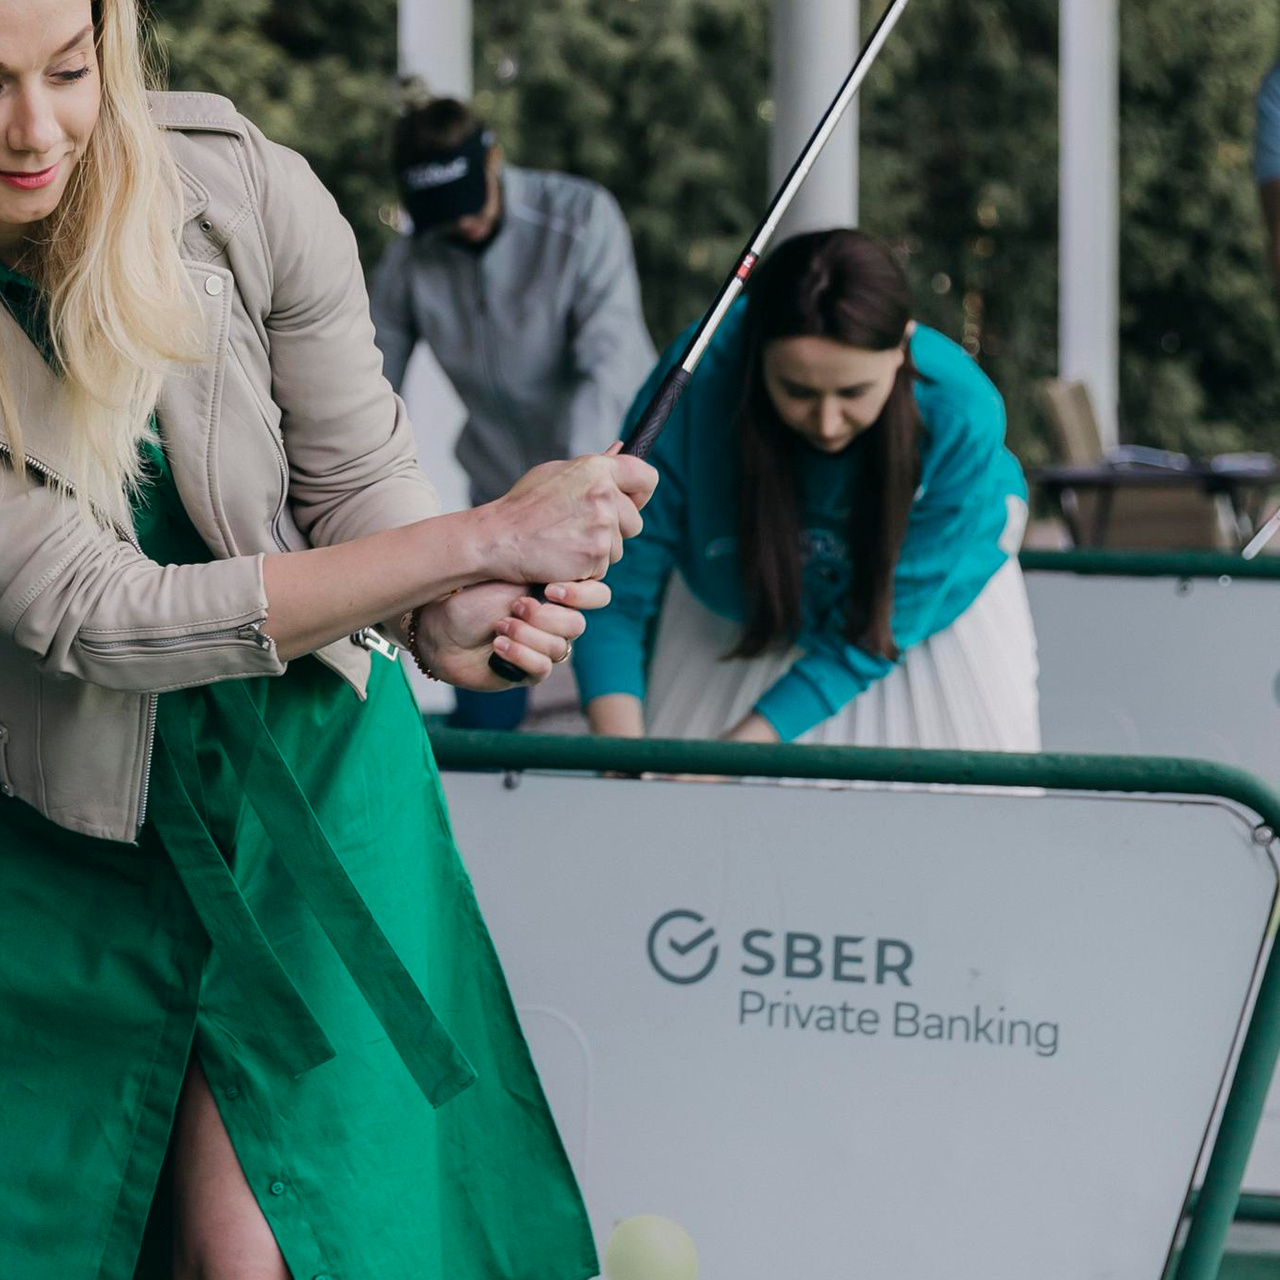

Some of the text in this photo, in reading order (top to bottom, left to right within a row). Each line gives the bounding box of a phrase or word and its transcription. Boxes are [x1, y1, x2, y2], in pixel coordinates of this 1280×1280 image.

[740, 928, 914, 987] SBER
[738, 989, 1060, 1058] Private Banking
